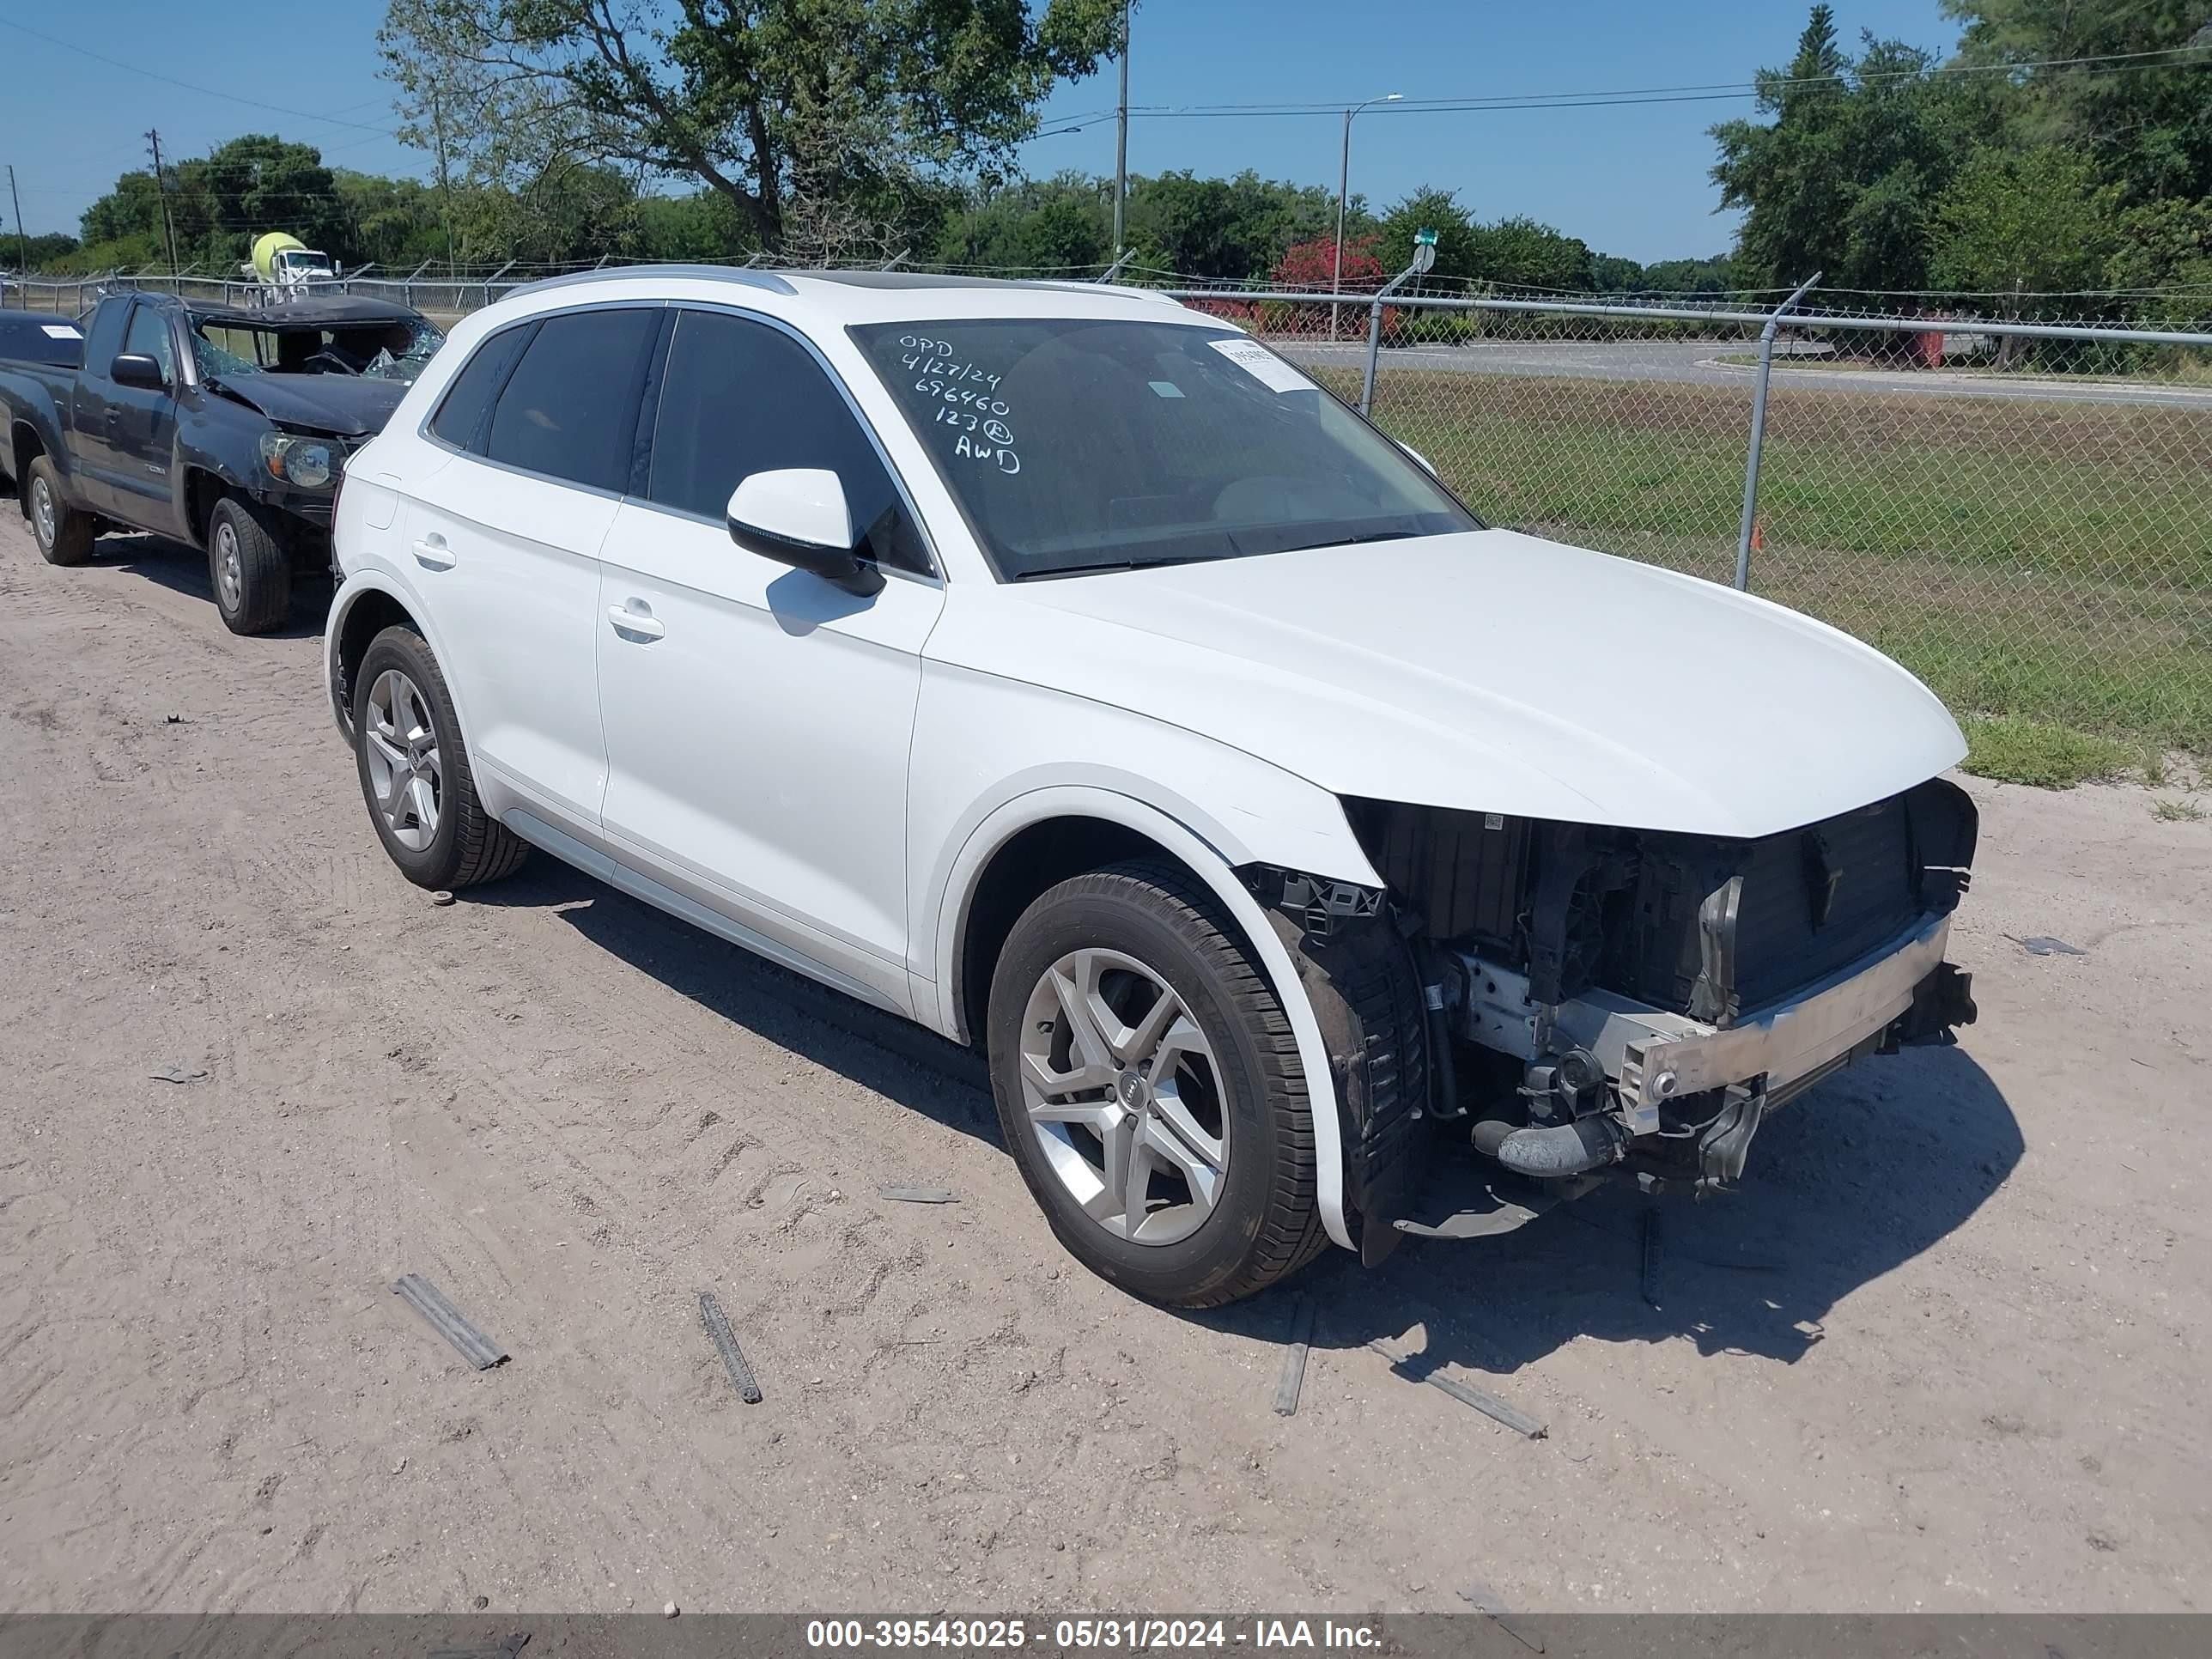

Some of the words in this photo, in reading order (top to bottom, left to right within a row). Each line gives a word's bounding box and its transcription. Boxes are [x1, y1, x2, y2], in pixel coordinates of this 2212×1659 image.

[900, 336, 953, 356] OPD
[902, 354, 1001, 392] 4/27/24
[935, 406, 978, 431] 123
[955, 435, 1020, 474] AWD
